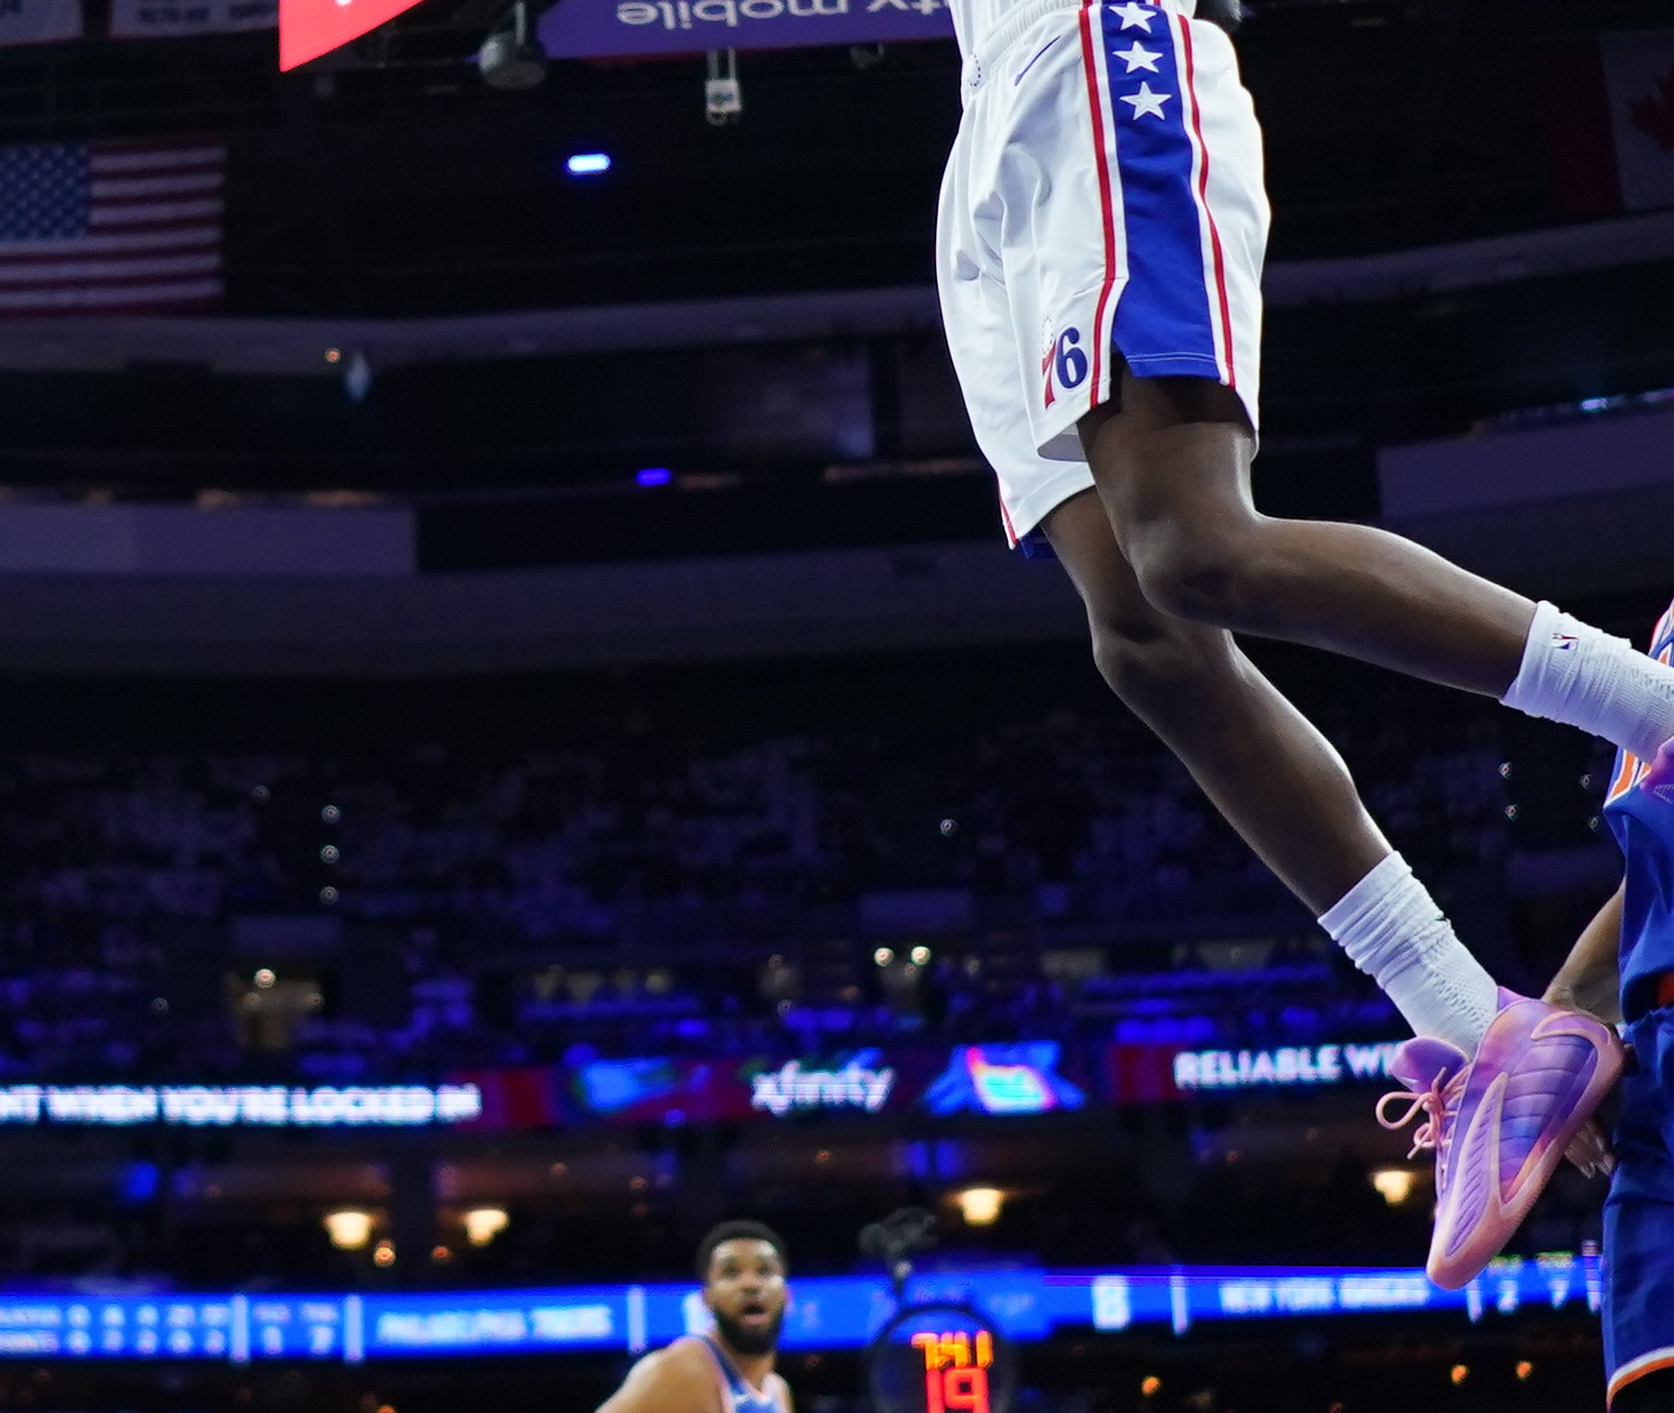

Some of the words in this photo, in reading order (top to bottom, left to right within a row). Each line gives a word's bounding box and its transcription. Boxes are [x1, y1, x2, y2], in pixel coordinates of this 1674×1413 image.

[1042, 325, 1089, 412] 76
[751, 1059, 895, 1116] xfinity
[1174, 1044, 1342, 1089] RELIABLE
